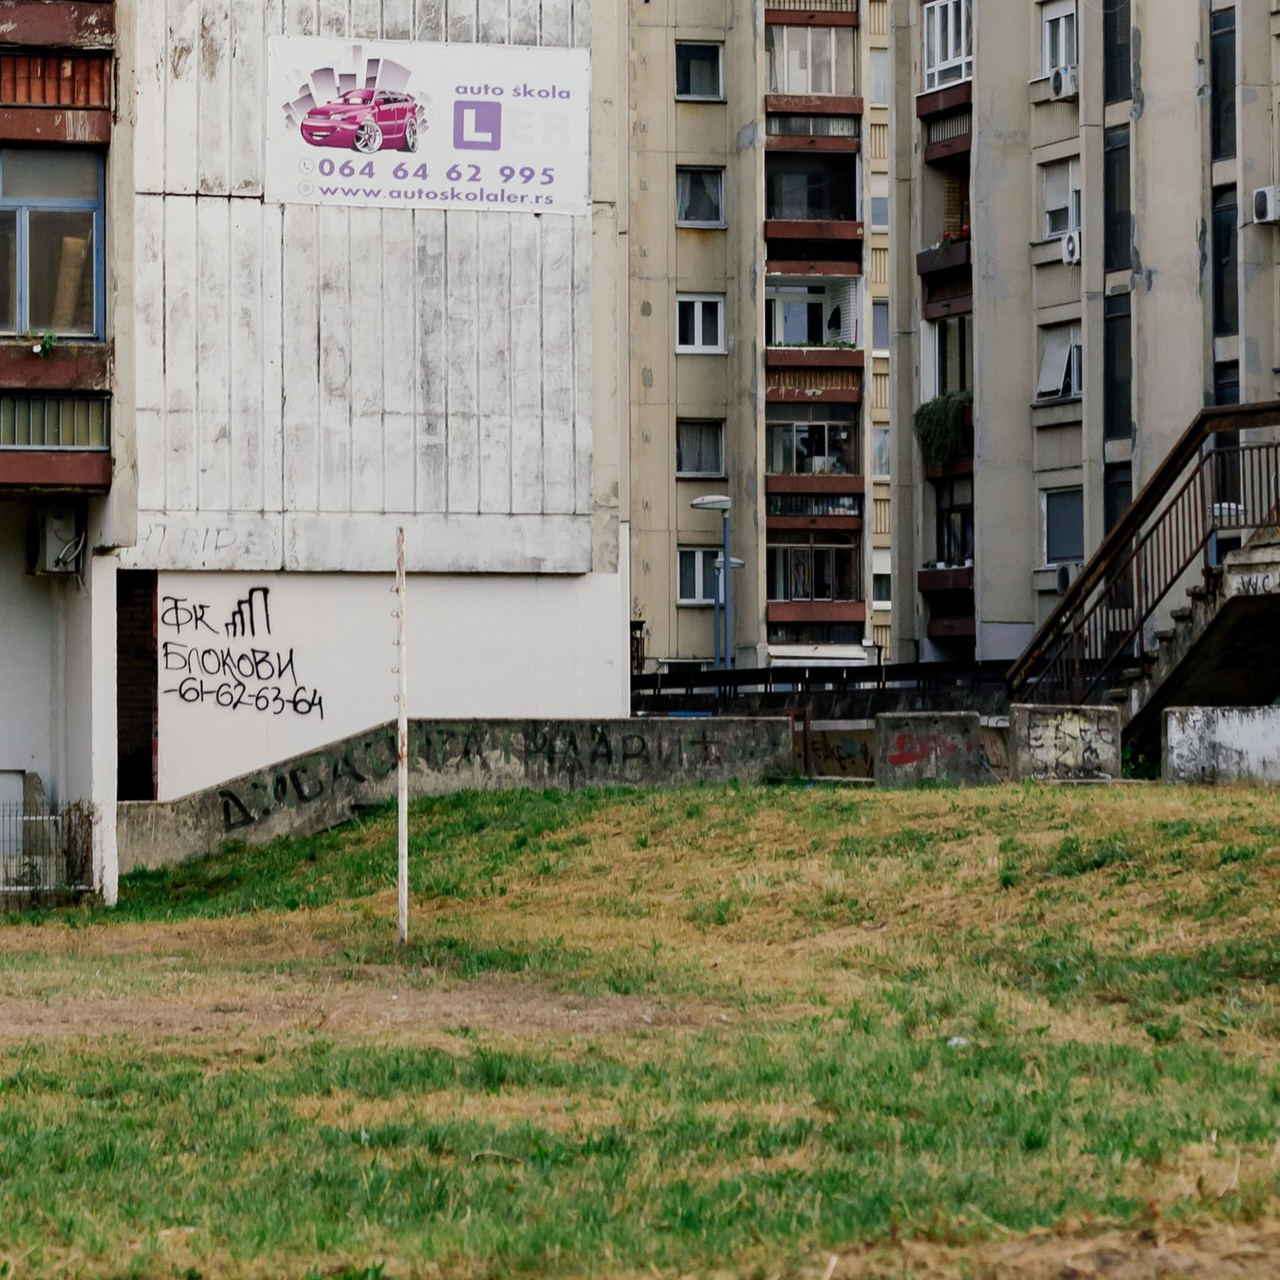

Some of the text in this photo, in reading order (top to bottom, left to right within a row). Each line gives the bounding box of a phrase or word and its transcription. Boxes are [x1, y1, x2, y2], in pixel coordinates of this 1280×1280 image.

[455, 84, 571, 99] auto škola
[319, 158, 555, 186] 064 64 62 995
[319, 187, 554, 205] www.autoskolaler.rs
[1241, 574, 1280, 595] WC
